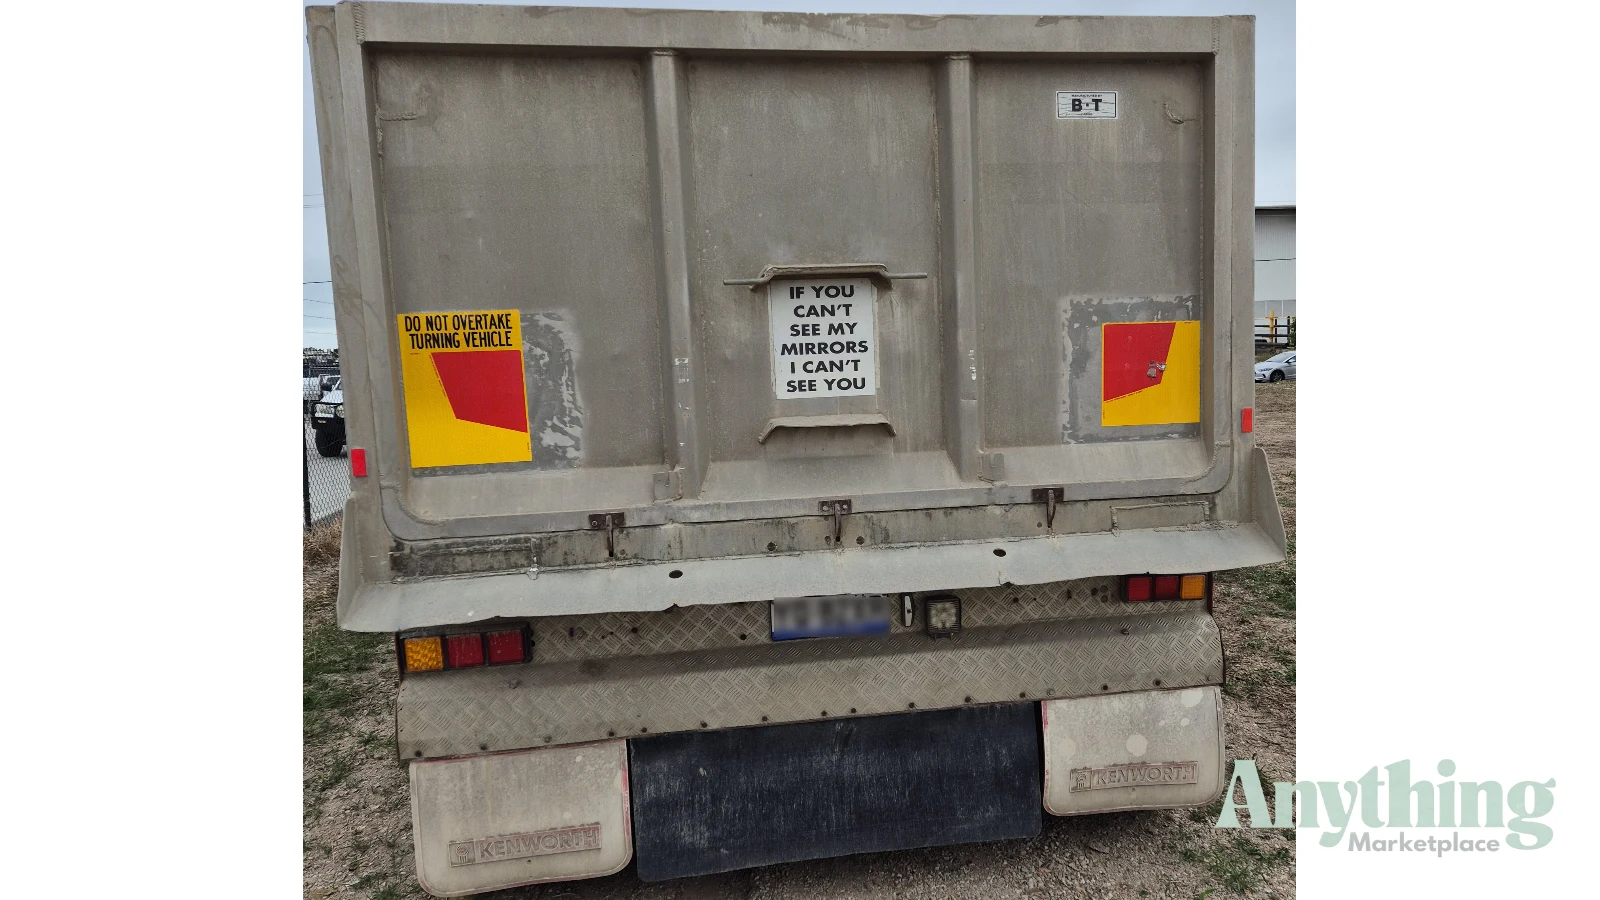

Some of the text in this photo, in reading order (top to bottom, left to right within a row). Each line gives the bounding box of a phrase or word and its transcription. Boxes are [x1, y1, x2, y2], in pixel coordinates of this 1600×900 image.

[789, 285, 855, 299] IF YOU
[793, 304, 853, 318] CAN'T
[404, 313, 513, 332] DO NOT OVERTAKE
[790, 322, 858, 337] SEE MY
[409, 331, 513, 349] TURNING VEHICLE
[780, 340, 869, 356] MIRRORS
[790, 359, 861, 374] I CAN'T
[786, 377, 866, 393] SEE YOU
[1095, 765, 1196, 786] KENWORTH
[480, 829, 597, 859] KENWORTH
